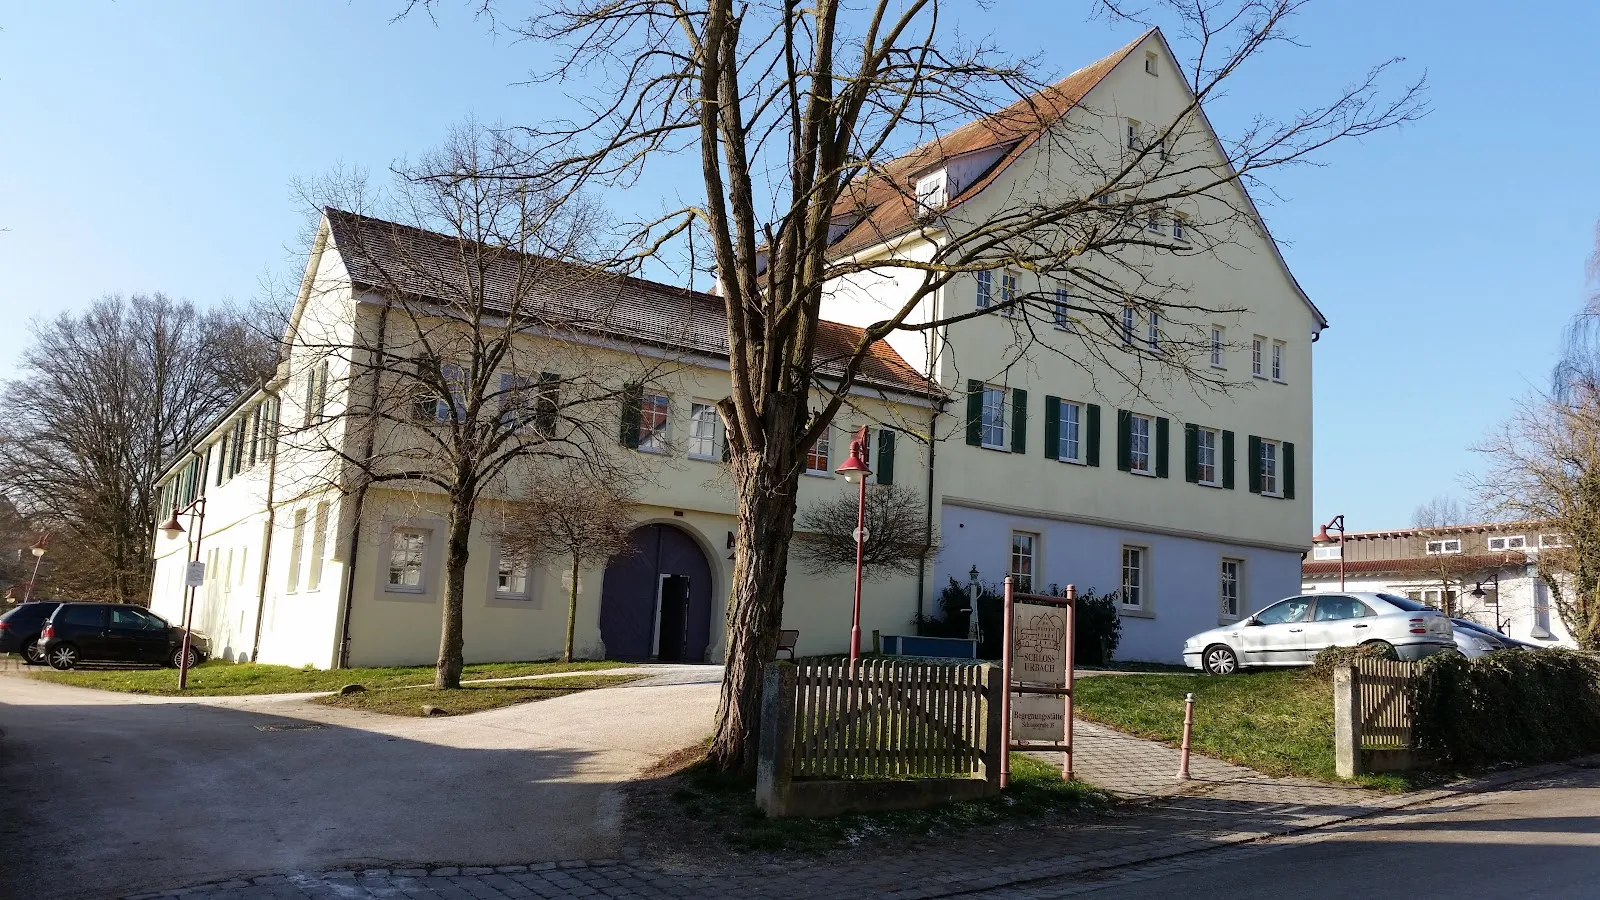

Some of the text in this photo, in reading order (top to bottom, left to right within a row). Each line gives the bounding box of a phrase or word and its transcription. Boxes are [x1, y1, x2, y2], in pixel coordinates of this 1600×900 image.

[1024, 653, 1056, 663] SCHLOSS
[1024, 662, 1055, 673] URBACH
[1014, 711, 1063, 721] Begegnungsstätte
